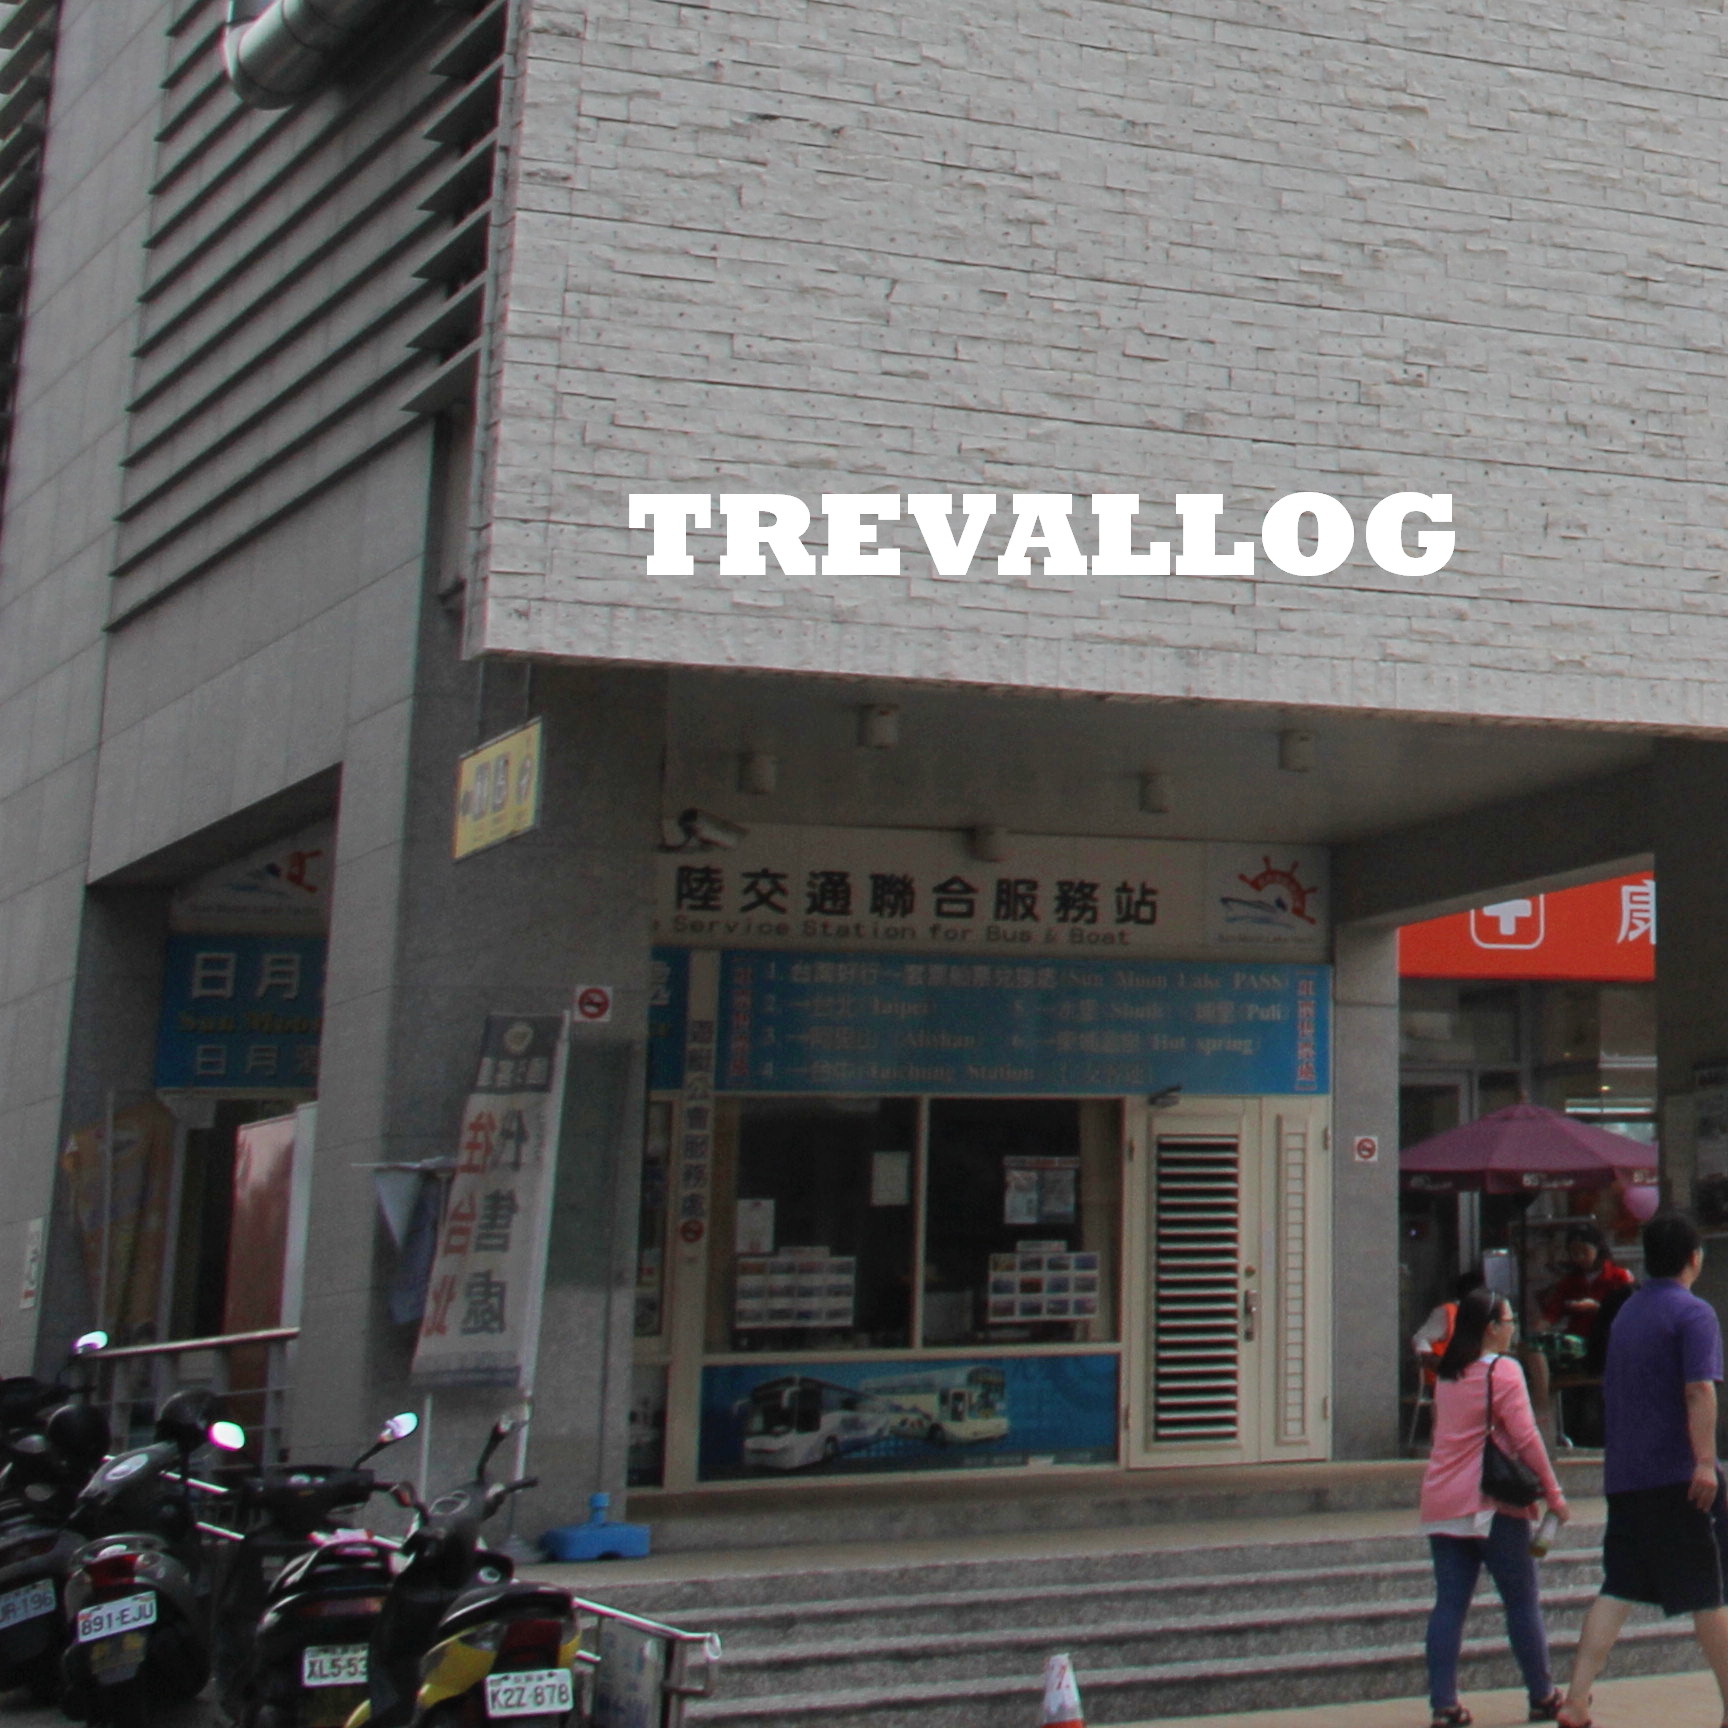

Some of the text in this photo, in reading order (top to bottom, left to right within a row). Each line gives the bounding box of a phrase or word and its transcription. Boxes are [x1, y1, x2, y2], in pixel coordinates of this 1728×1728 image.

[674, 913, 790, 940] Service
[802, 918, 917, 942] Station
[929, 923, 973, 943] for
[985, 925, 1032, 945] Bus
[1068, 927, 1131, 947] Boat
